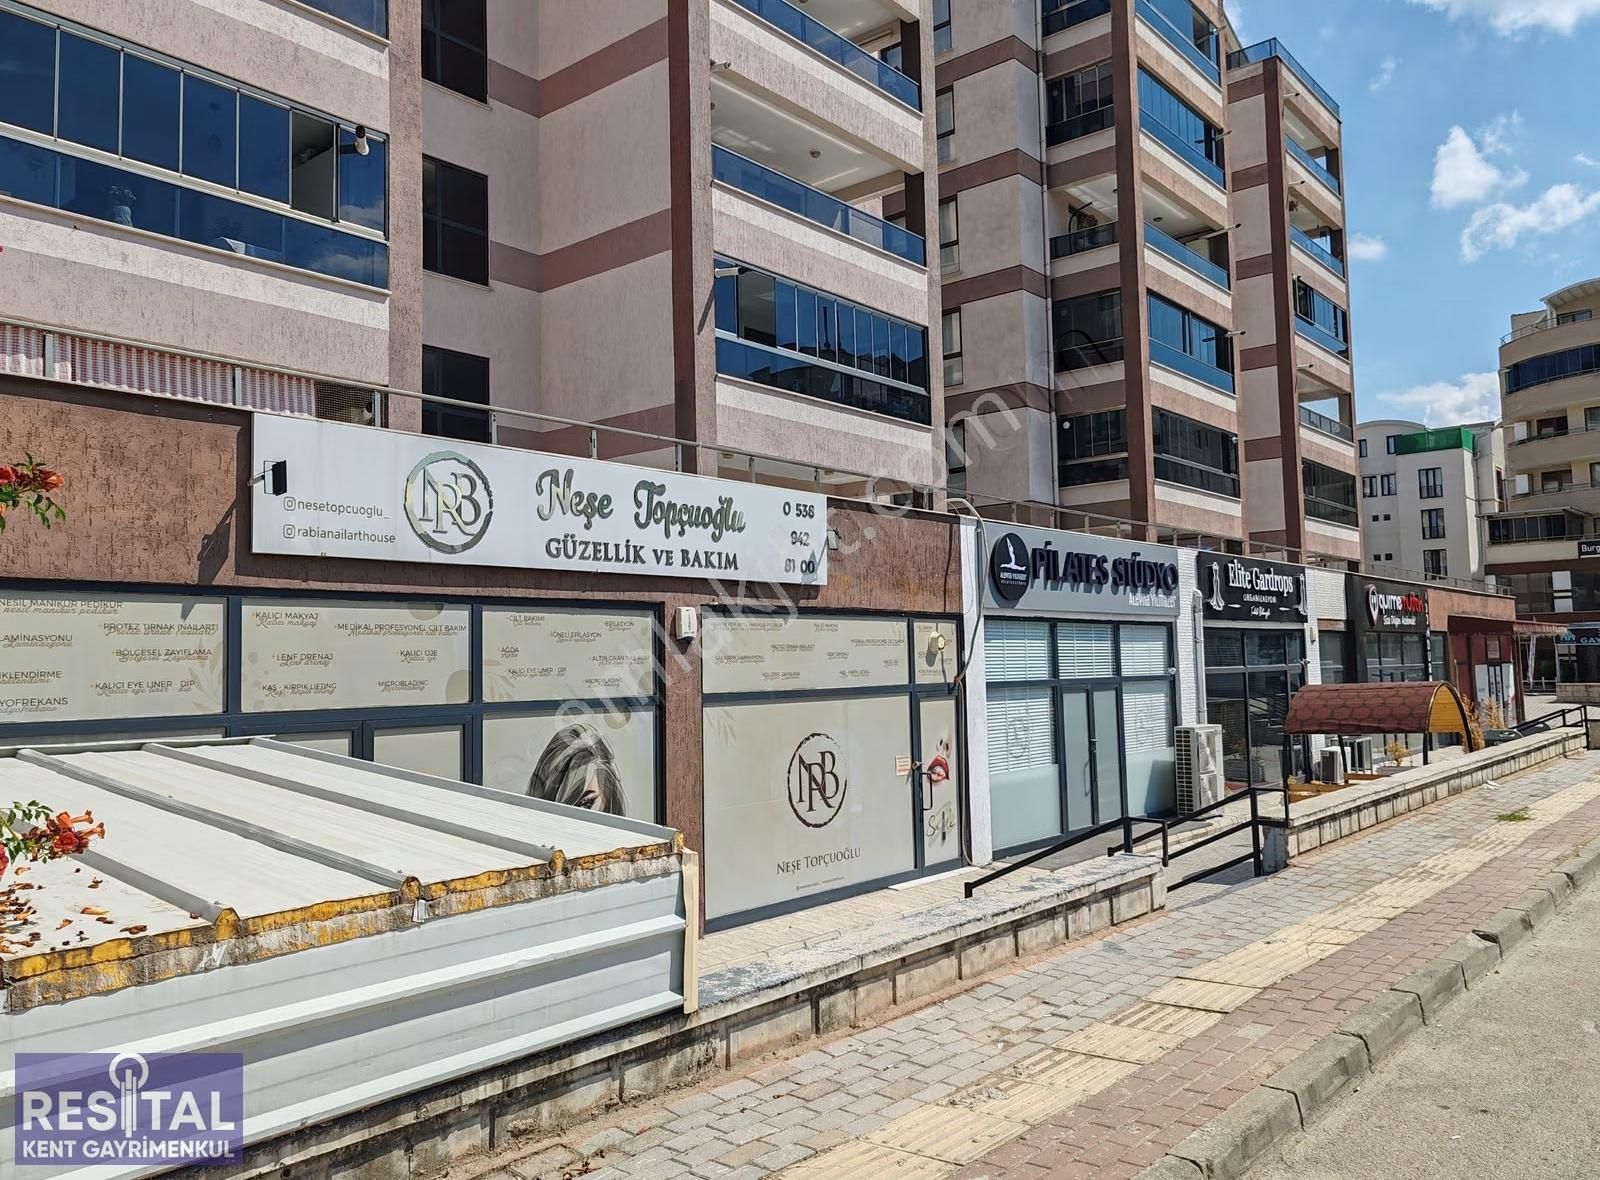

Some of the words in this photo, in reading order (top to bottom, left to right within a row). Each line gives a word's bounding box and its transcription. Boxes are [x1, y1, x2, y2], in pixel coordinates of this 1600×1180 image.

[536, 468, 614, 530] Neşe
[634, 480, 746, 542] Topçuoğlu
[795, 502, 815, 519] 538
[297, 526, 396, 544] rabianailarthouse
[790, 531, 809, 546] 942
[545, 533, 646, 564] GÜZELLİK
[653, 549, 674, 567] VE
[680, 549, 739, 571] BAKIM
[1030, 541, 1109, 584] PİLATES
[1111, 552, 1178, 591] STÜDYO
[1227, 559, 1251, 590] Elite
[1252, 567, 1294, 597] Gardrops
[803, 847, 861, 869] TOPÇUOĞLU
